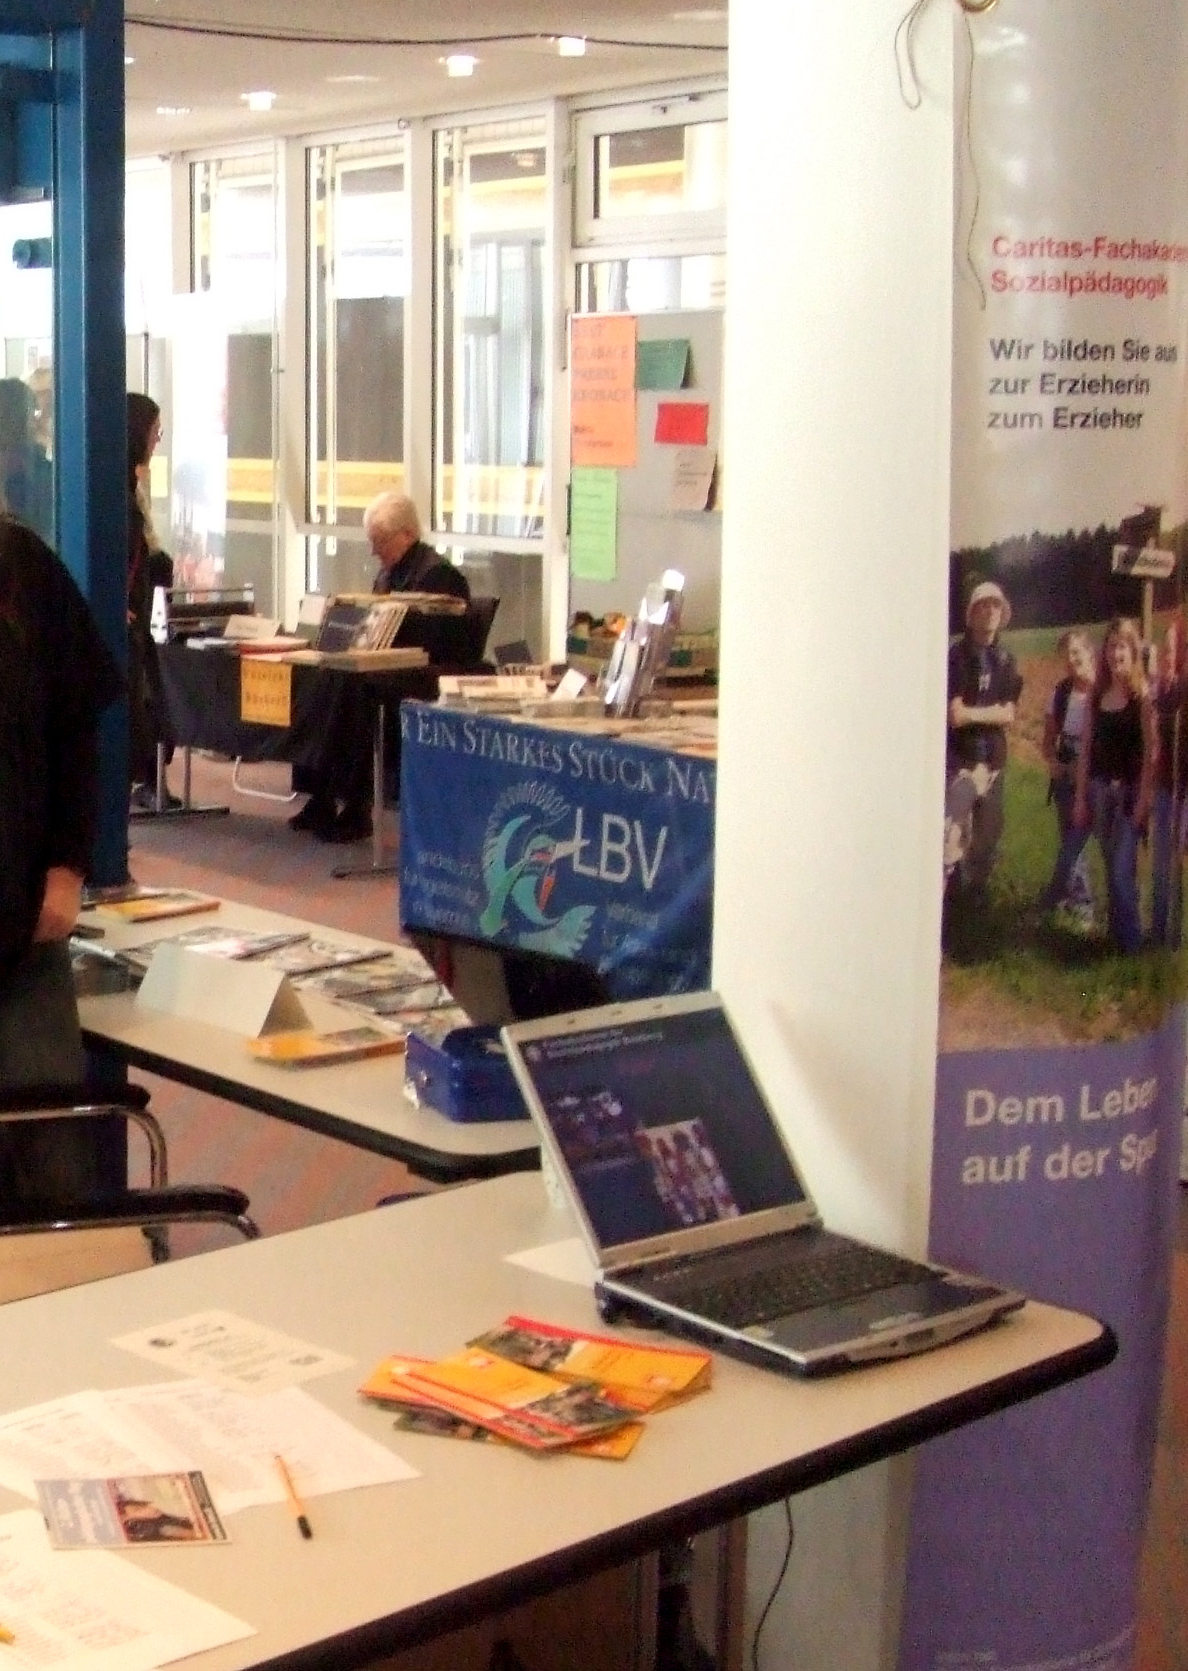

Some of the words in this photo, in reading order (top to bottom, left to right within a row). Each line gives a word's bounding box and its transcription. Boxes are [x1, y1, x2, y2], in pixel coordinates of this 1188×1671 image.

[989, 338, 1034, 362] Wir
[1043, 338, 1115, 362] bilden
[1122, 338, 1150, 361] Sie
[989, 377, 1031, 396] zur
[1040, 372, 1150, 396] Erzieherin
[987, 410, 1043, 430] zum
[1053, 406, 1143, 429] Erzieher
[570, 806, 669, 893] LBV
[965, 1088, 1064, 1127] Dem
[962, 1145, 1032, 1185] auf
[1043, 1143, 1112, 1181] der
